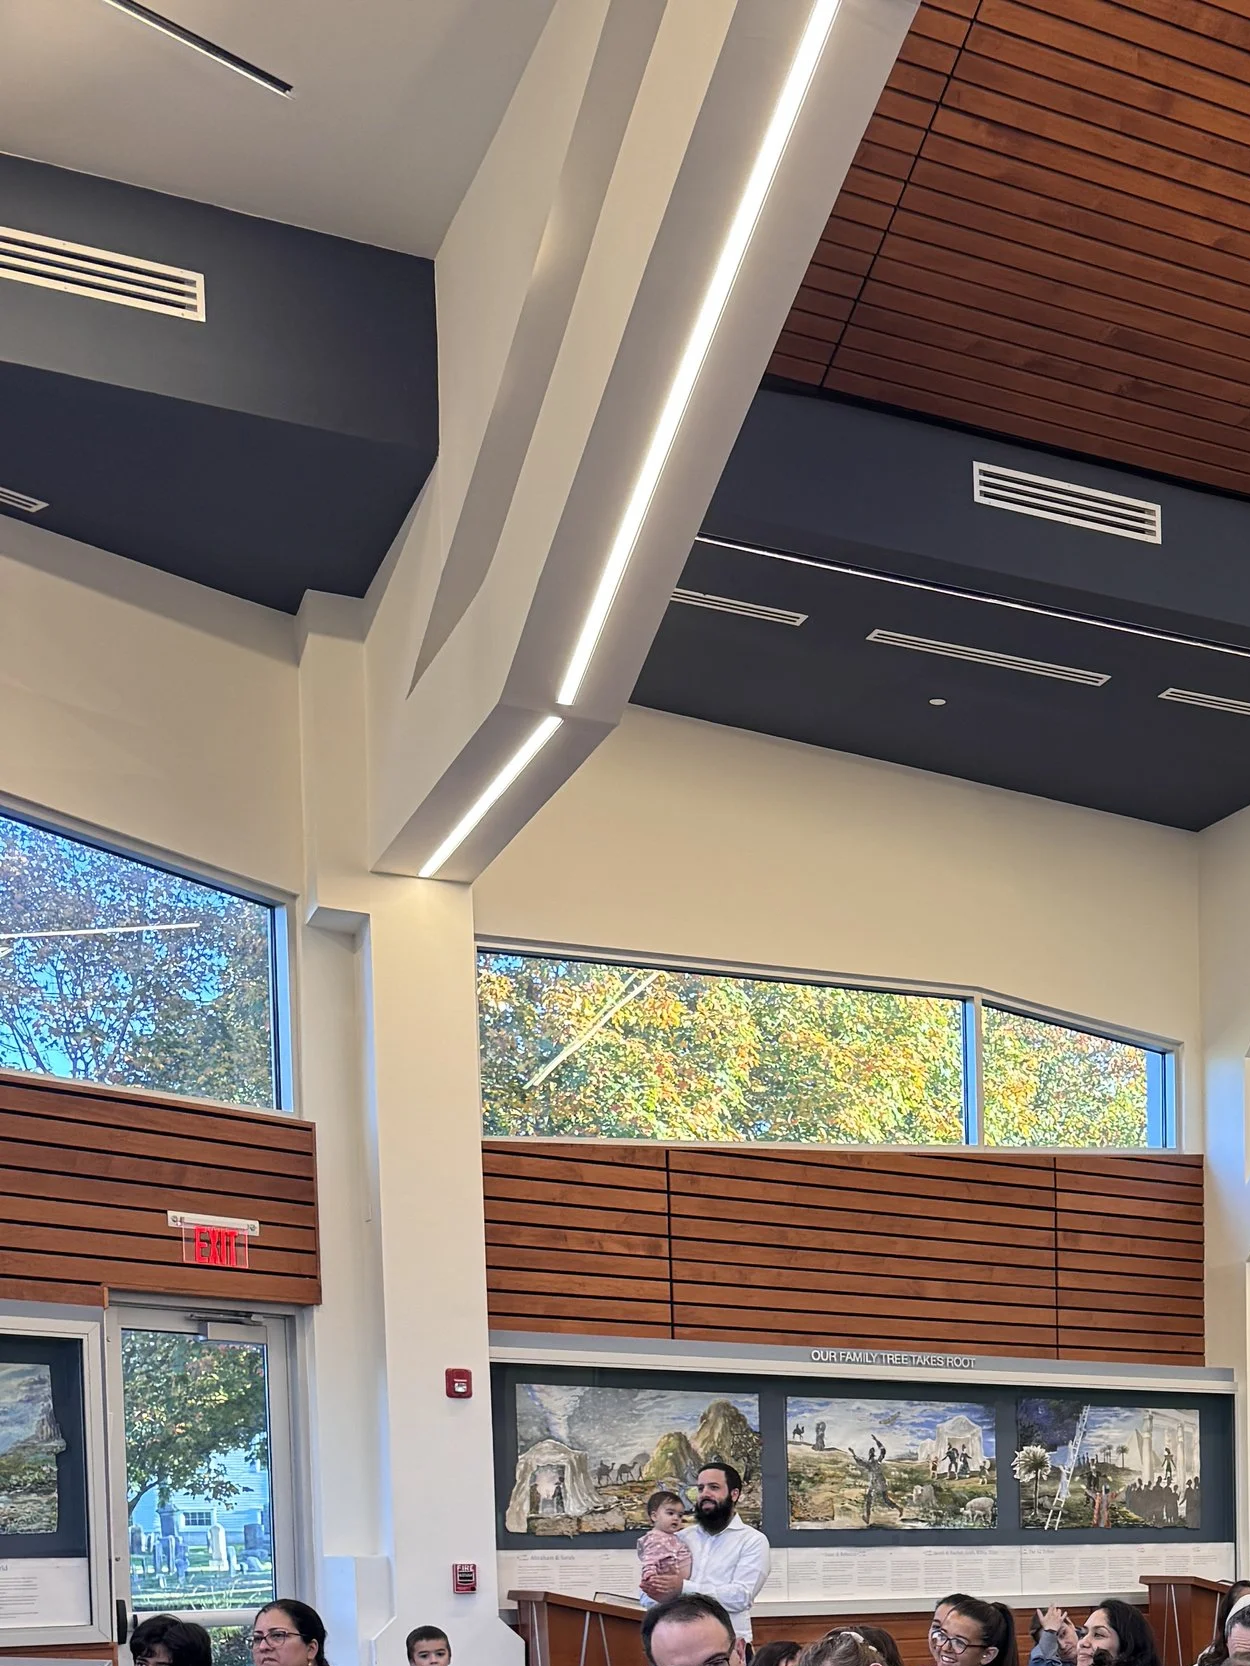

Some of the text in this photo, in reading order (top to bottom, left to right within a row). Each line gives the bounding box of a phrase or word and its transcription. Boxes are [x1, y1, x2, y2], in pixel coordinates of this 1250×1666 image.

[194, 1226, 238, 1266] EXIT
[811, 1350, 976, 1369] OUR FAMILY TREE TAKES ROOT
